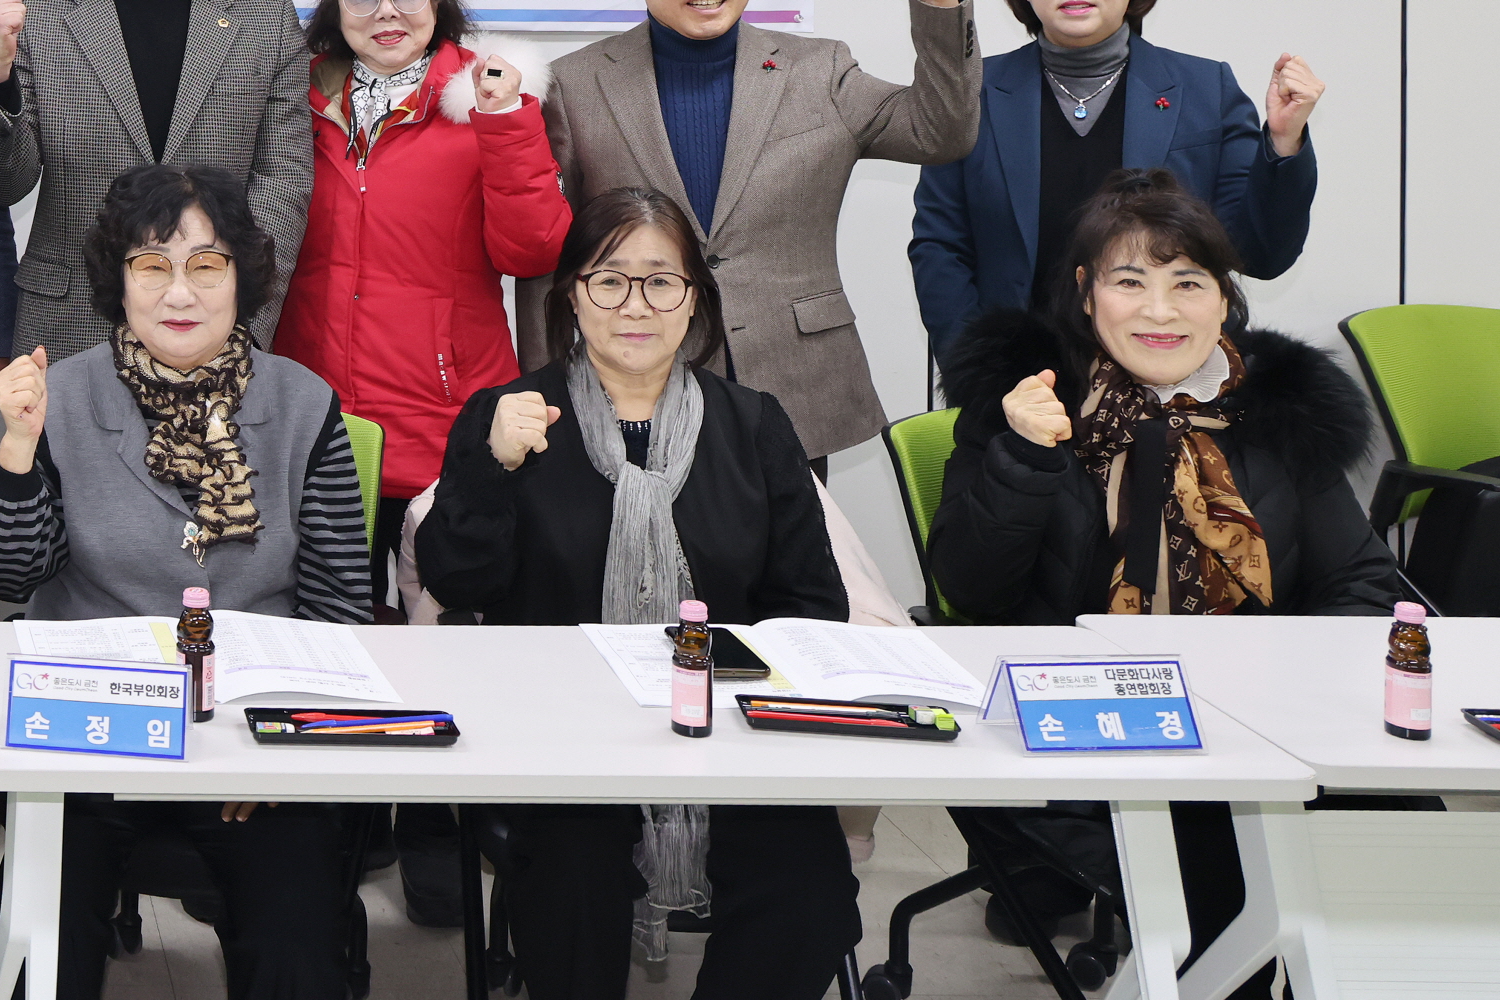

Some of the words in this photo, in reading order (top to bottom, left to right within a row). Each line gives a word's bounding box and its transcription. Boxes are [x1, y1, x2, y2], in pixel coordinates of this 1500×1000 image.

[1104, 667, 1174, 681] 다문화다사랑
[109, 682, 180, 699] 한국부인회장
[1114, 682, 1172, 696] 총연합회장
